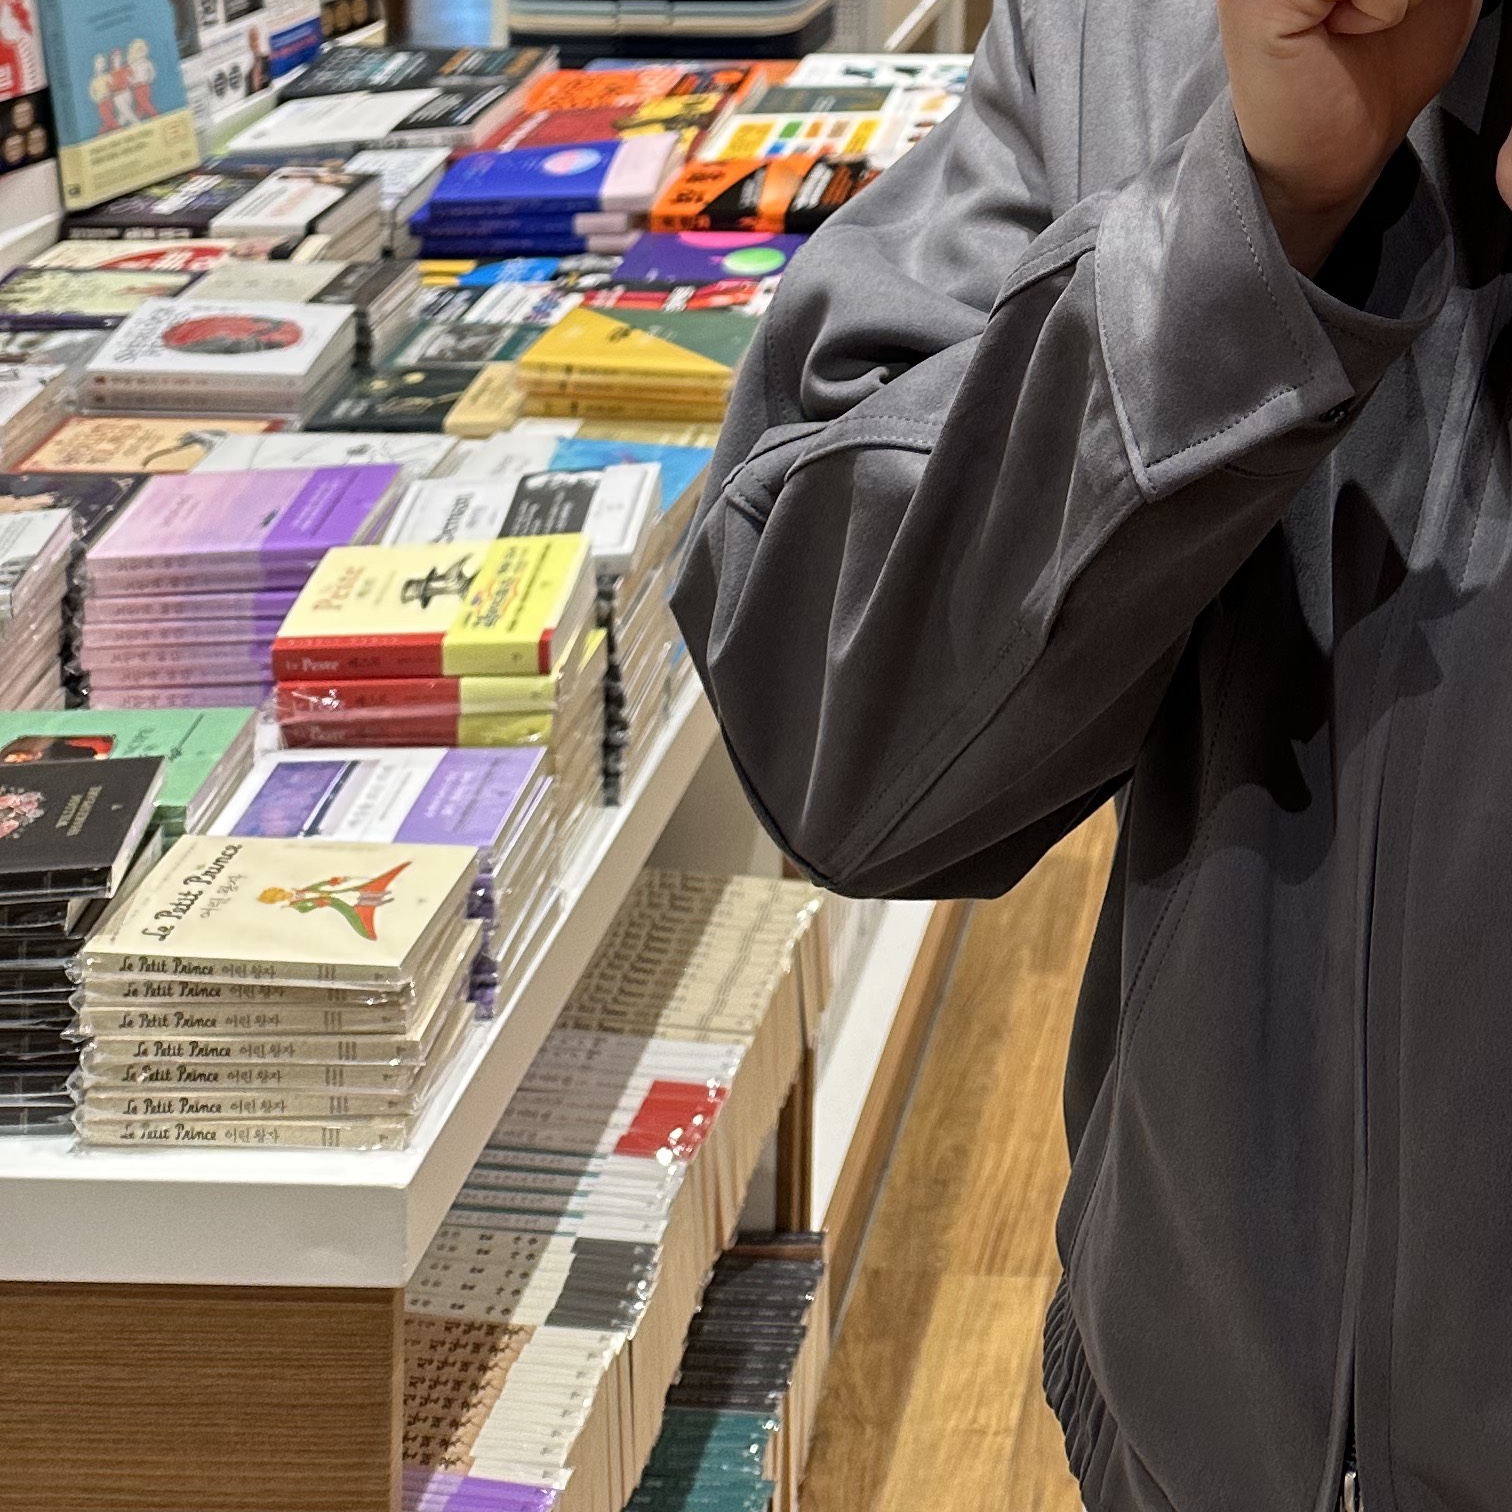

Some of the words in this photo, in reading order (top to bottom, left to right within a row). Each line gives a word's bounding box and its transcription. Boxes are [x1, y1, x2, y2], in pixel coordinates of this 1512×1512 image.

[183, 843, 243, 887] Prince
[155, 882, 203, 922] Petit
[142, 924, 174, 941] Le
[119, 957, 136, 972] Le
[139, 958, 168, 973] Petit
[173, 958, 214, 976] Prince
[143, 981, 172, 998] Petit
[179, 982, 221, 999] Prince
[119, 1014, 135, 1029] Le
[139, 1011, 169, 1028] Petit
[174, 1012, 217, 1028] Prince
[134, 1041, 148, 1057] Le
[154, 1041, 184, 1058] Petit
[189, 1041, 231, 1057] Prince
[179, 1066, 219, 1082] Prince
[123, 1099, 138, 1115] Le
[144, 1097, 174, 1114] Petit
[179, 1098, 221, 1114] Prince
[174, 1125, 217, 1142] Prince
